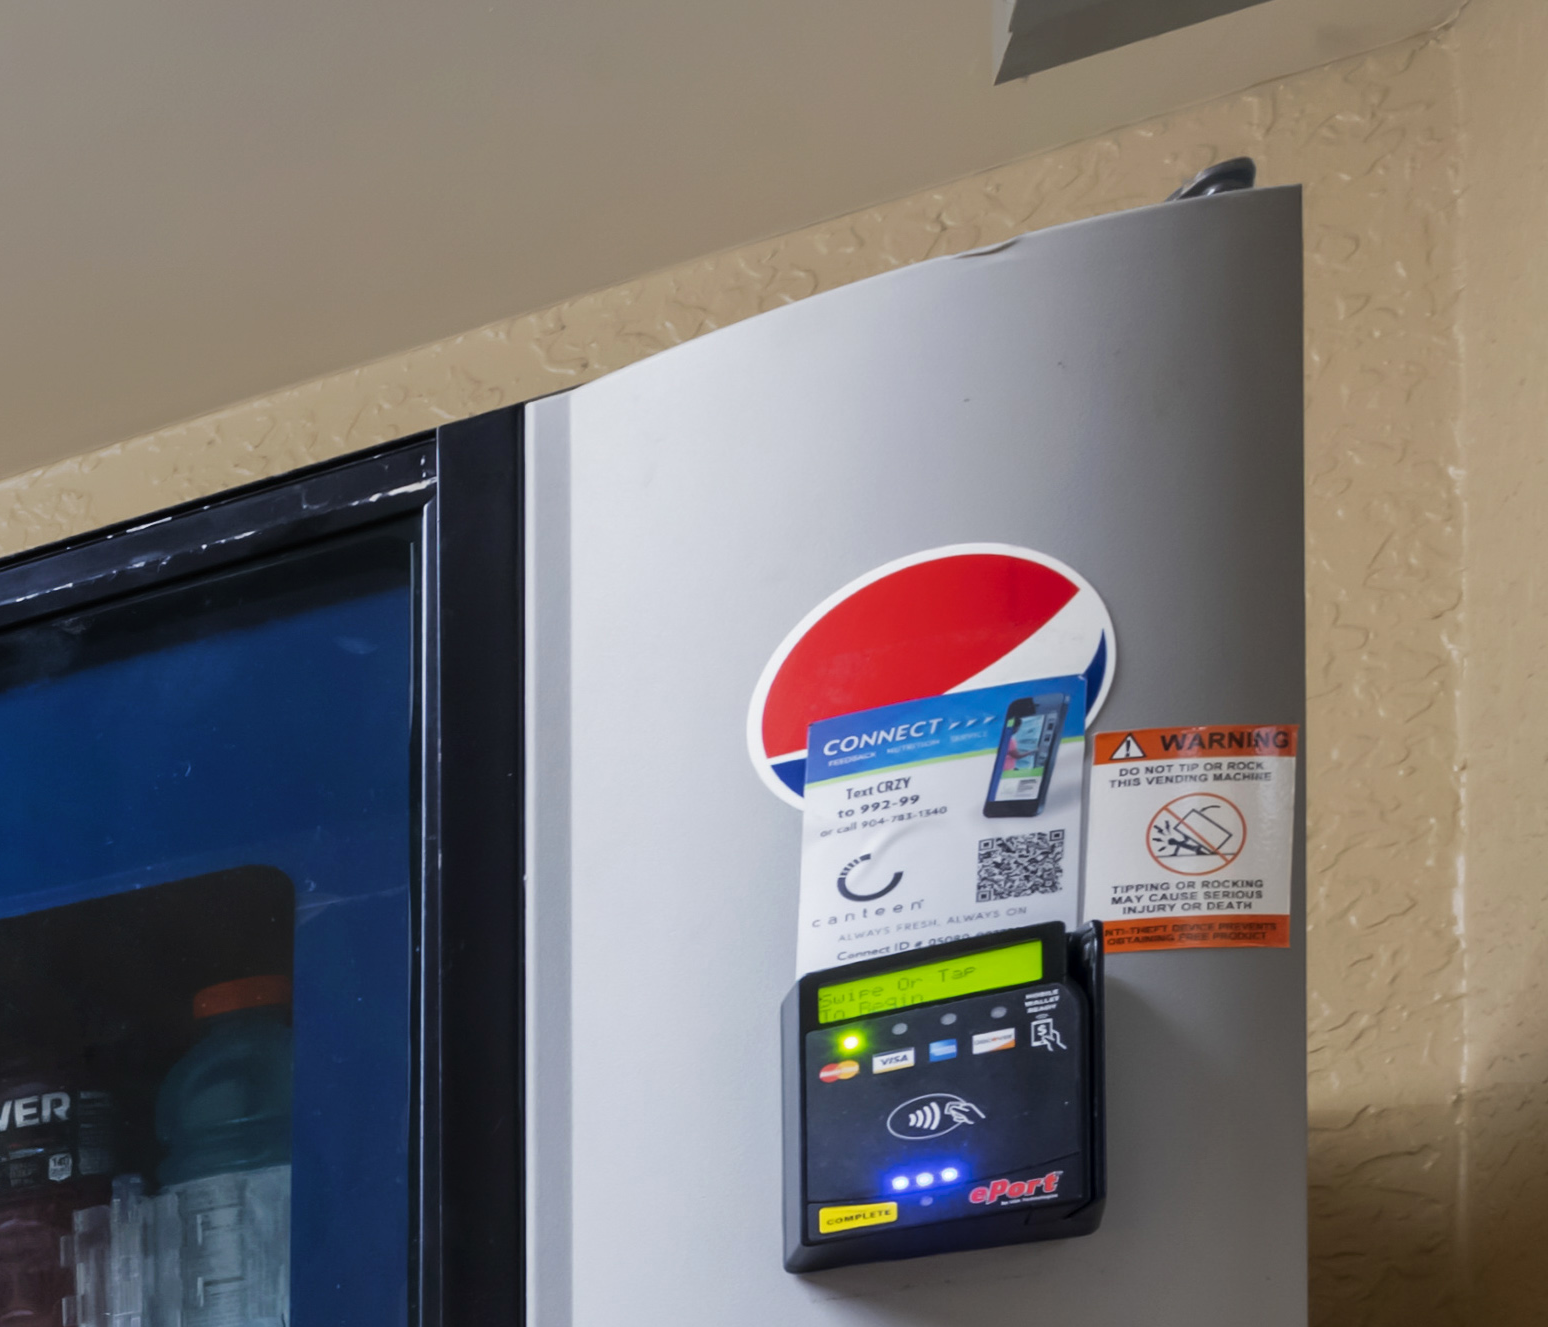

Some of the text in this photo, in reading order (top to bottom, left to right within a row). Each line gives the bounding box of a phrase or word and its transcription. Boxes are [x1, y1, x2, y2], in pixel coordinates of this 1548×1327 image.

[823, 718, 943, 755] CONNECT
[1161, 732, 1289, 751] WARNING
[1119, 761, 1264, 777] DO NOT TIP OR ROCK
[846, 777, 911, 799] Text CRZY
[1109, 772, 1272, 789] THIS VENDING MACHINE
[838, 794, 920, 818] to 992-99
[820, 828, 833, 837] or
[837, 822, 856, 834] call
[1112, 879, 1264, 895] TIPPING OR ROCKING
[1111, 890, 1263, 905] MAY CAUSE SERIOUS
[811, 900, 925, 928] canteen
[1123, 901, 1252, 914] INJURY OR DEATH
[838, 926, 890, 942] ALWAYS
[947, 910, 1000, 925] ALWAYS
[1007, 907, 1027, 916] ON
[1105, 925, 1168, 937] NTI-THEFT
[836, 941, 910, 961] Connect ID
[819, 967, 975, 1008] Swipe Or Tap
[880, 1054, 908, 1067] VISA
[969, 1172, 1058, 1205] ePort
[826, 1209, 891, 1226] COMPLETE
